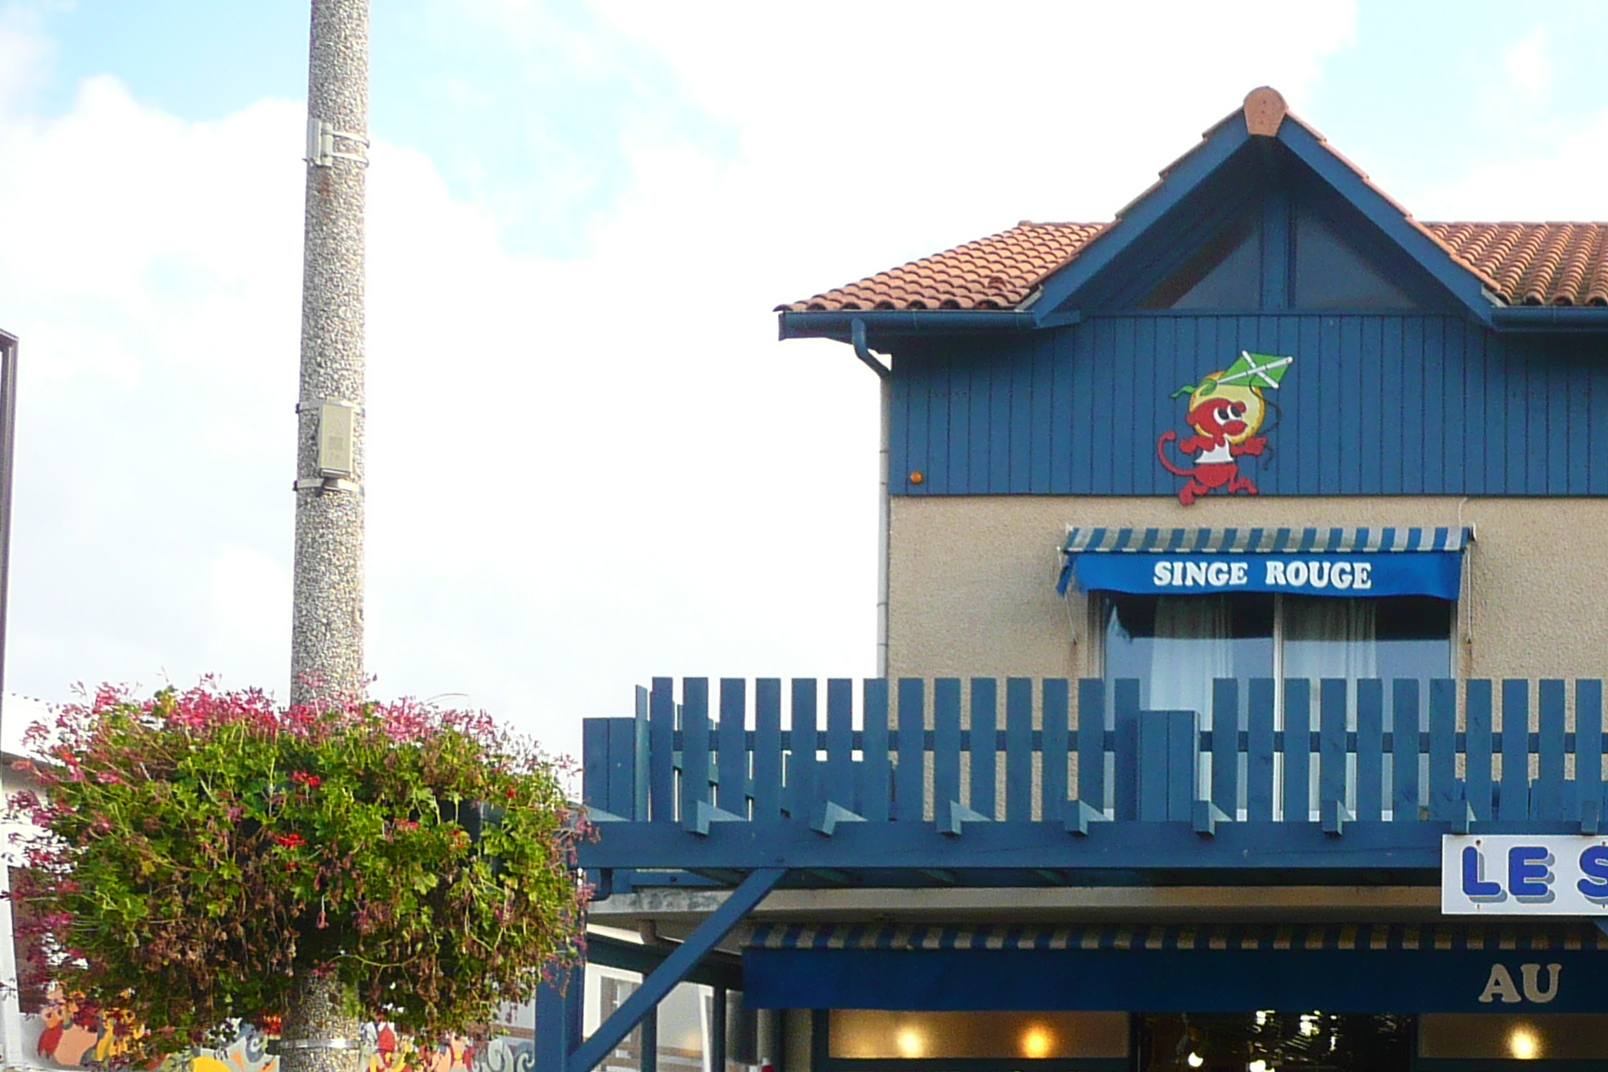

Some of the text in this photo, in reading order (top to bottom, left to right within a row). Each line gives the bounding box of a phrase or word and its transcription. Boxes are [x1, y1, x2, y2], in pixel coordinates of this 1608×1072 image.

[1153, 561, 1372, 589] SINGE ROUGE
[1461, 846, 1555, 903] LE
[1478, 962, 1562, 1003] AU
